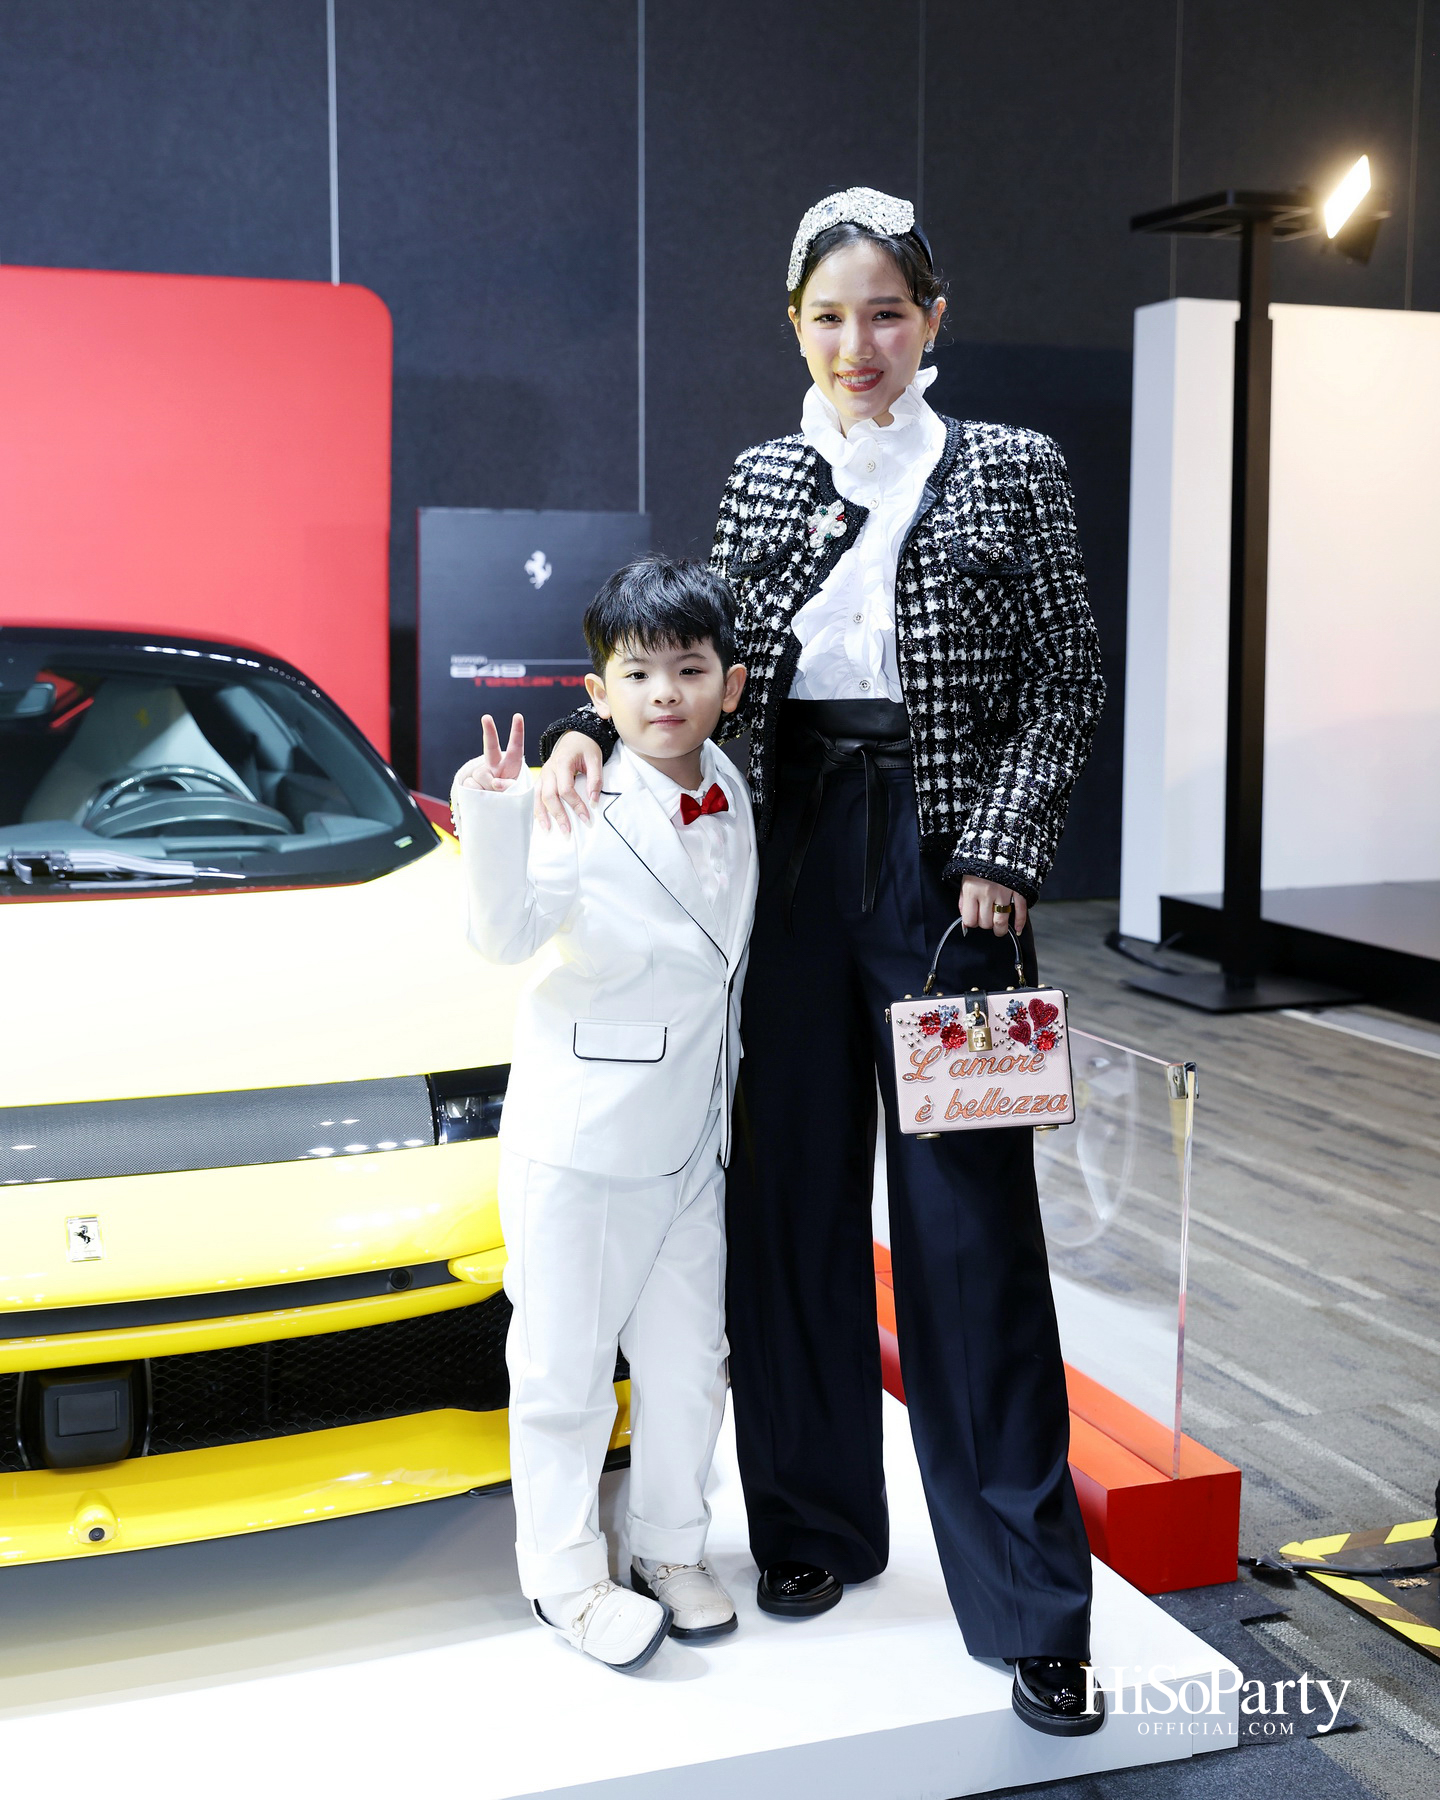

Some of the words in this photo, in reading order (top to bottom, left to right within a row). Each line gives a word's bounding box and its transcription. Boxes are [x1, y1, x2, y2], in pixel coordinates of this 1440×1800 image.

[474, 676, 585, 687] Testaro
[902, 1045, 1046, 1083] L'amore
[914, 1095, 934, 1124] è
[944, 1087, 1069, 1122] bellezza
